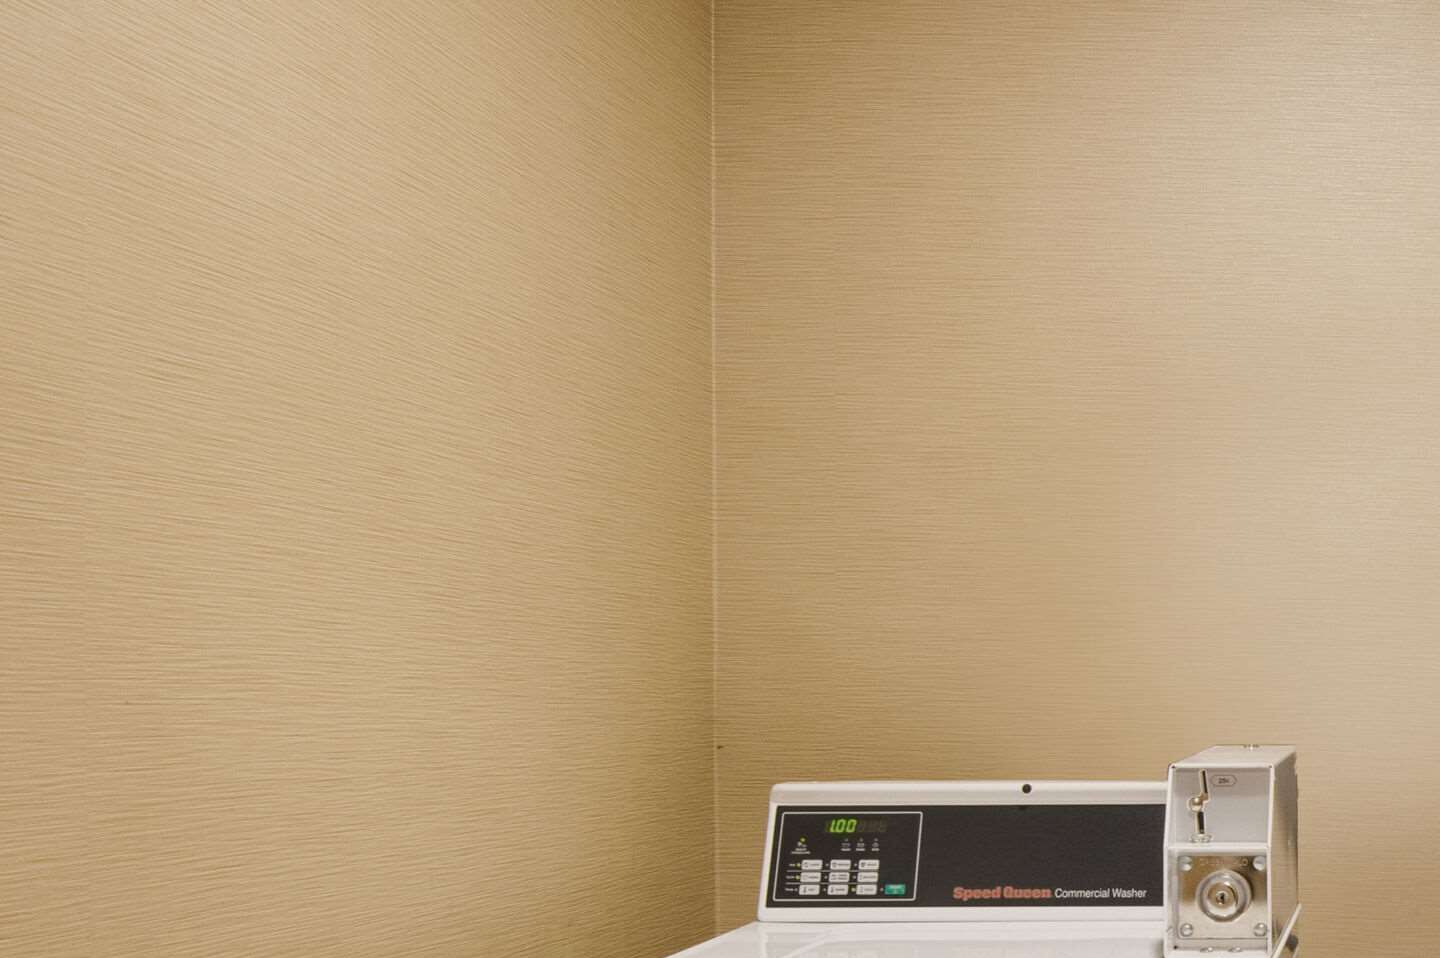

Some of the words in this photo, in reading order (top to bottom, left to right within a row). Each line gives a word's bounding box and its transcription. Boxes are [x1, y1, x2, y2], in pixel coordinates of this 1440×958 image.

[953, 886, 1001, 901] Speed
[1003, 886, 1052, 899] Queen
[1054, 887, 1110, 898] Commercial
[1112, 888, 1147, 898] Washer
